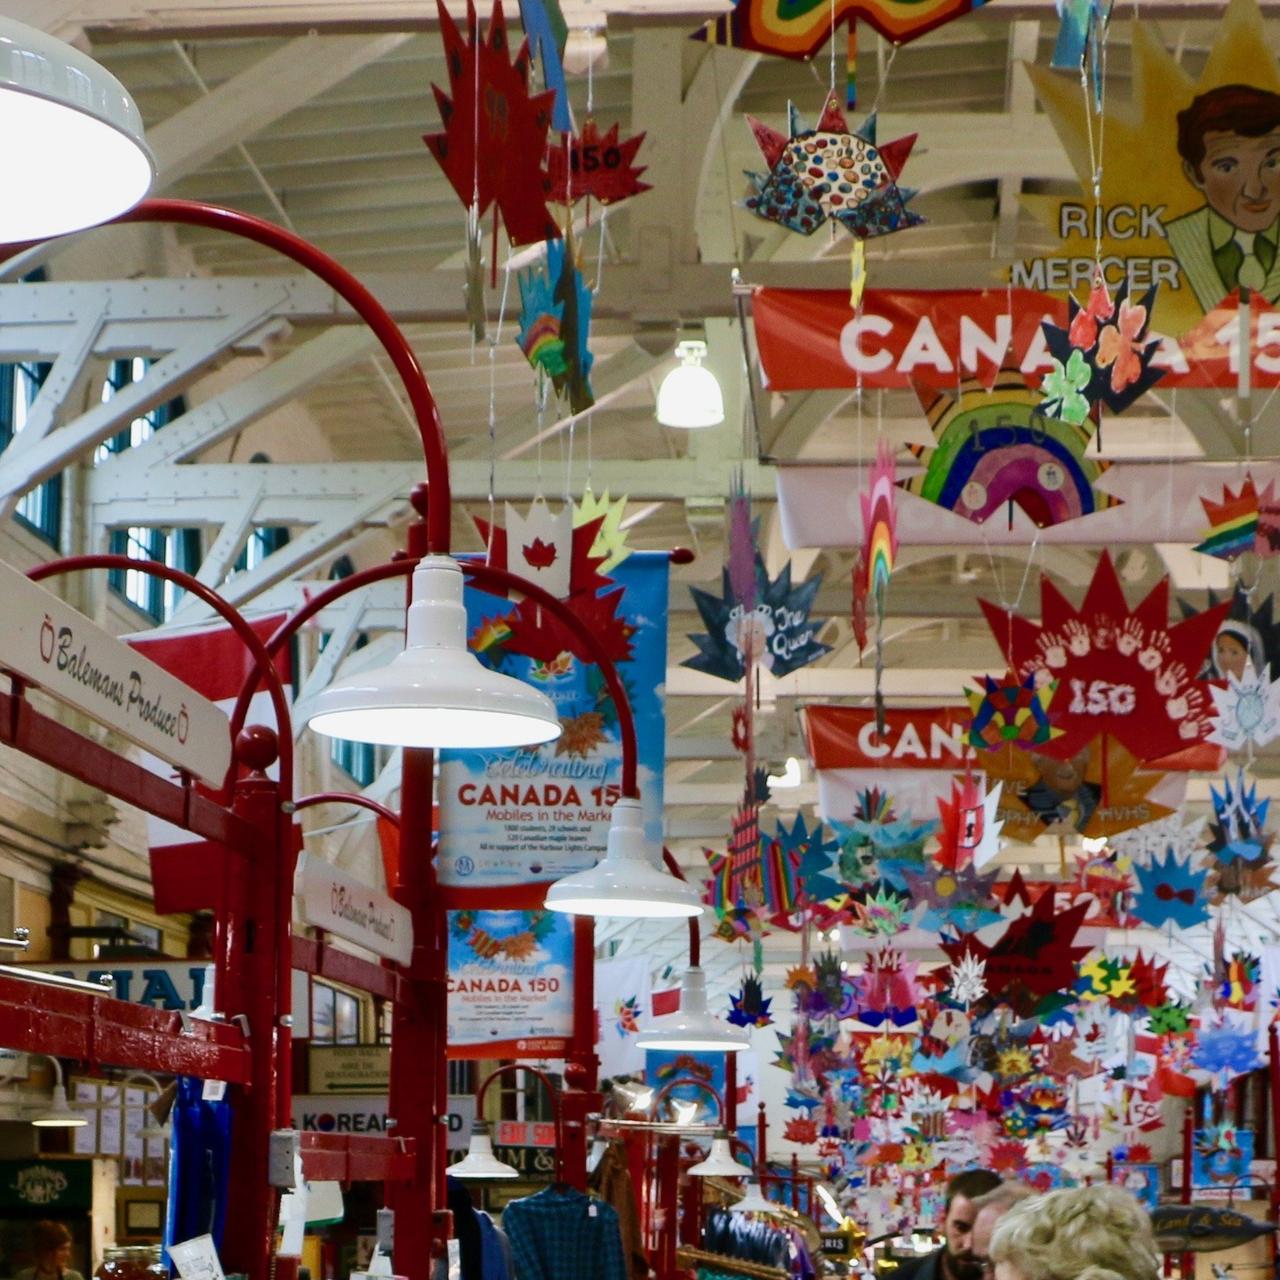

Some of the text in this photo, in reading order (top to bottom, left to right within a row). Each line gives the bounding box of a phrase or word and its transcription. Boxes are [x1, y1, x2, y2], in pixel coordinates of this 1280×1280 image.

[1058, 204, 1168, 242] RICK
[1010, 258, 1180, 290] MERCER
[775, 606, 804, 631] The
[772, 630, 814, 660] Queen
[57, 627, 177, 737] Balemans Produce
[1068, 678, 1136, 716] 150
[457, 783, 641, 807] CANADA 15
[486, 808, 534, 823] Mobiles
[537, 808, 550, 821] in
[553, 808, 574, 821] the
[447, 977, 560, 993] CANADA 150
